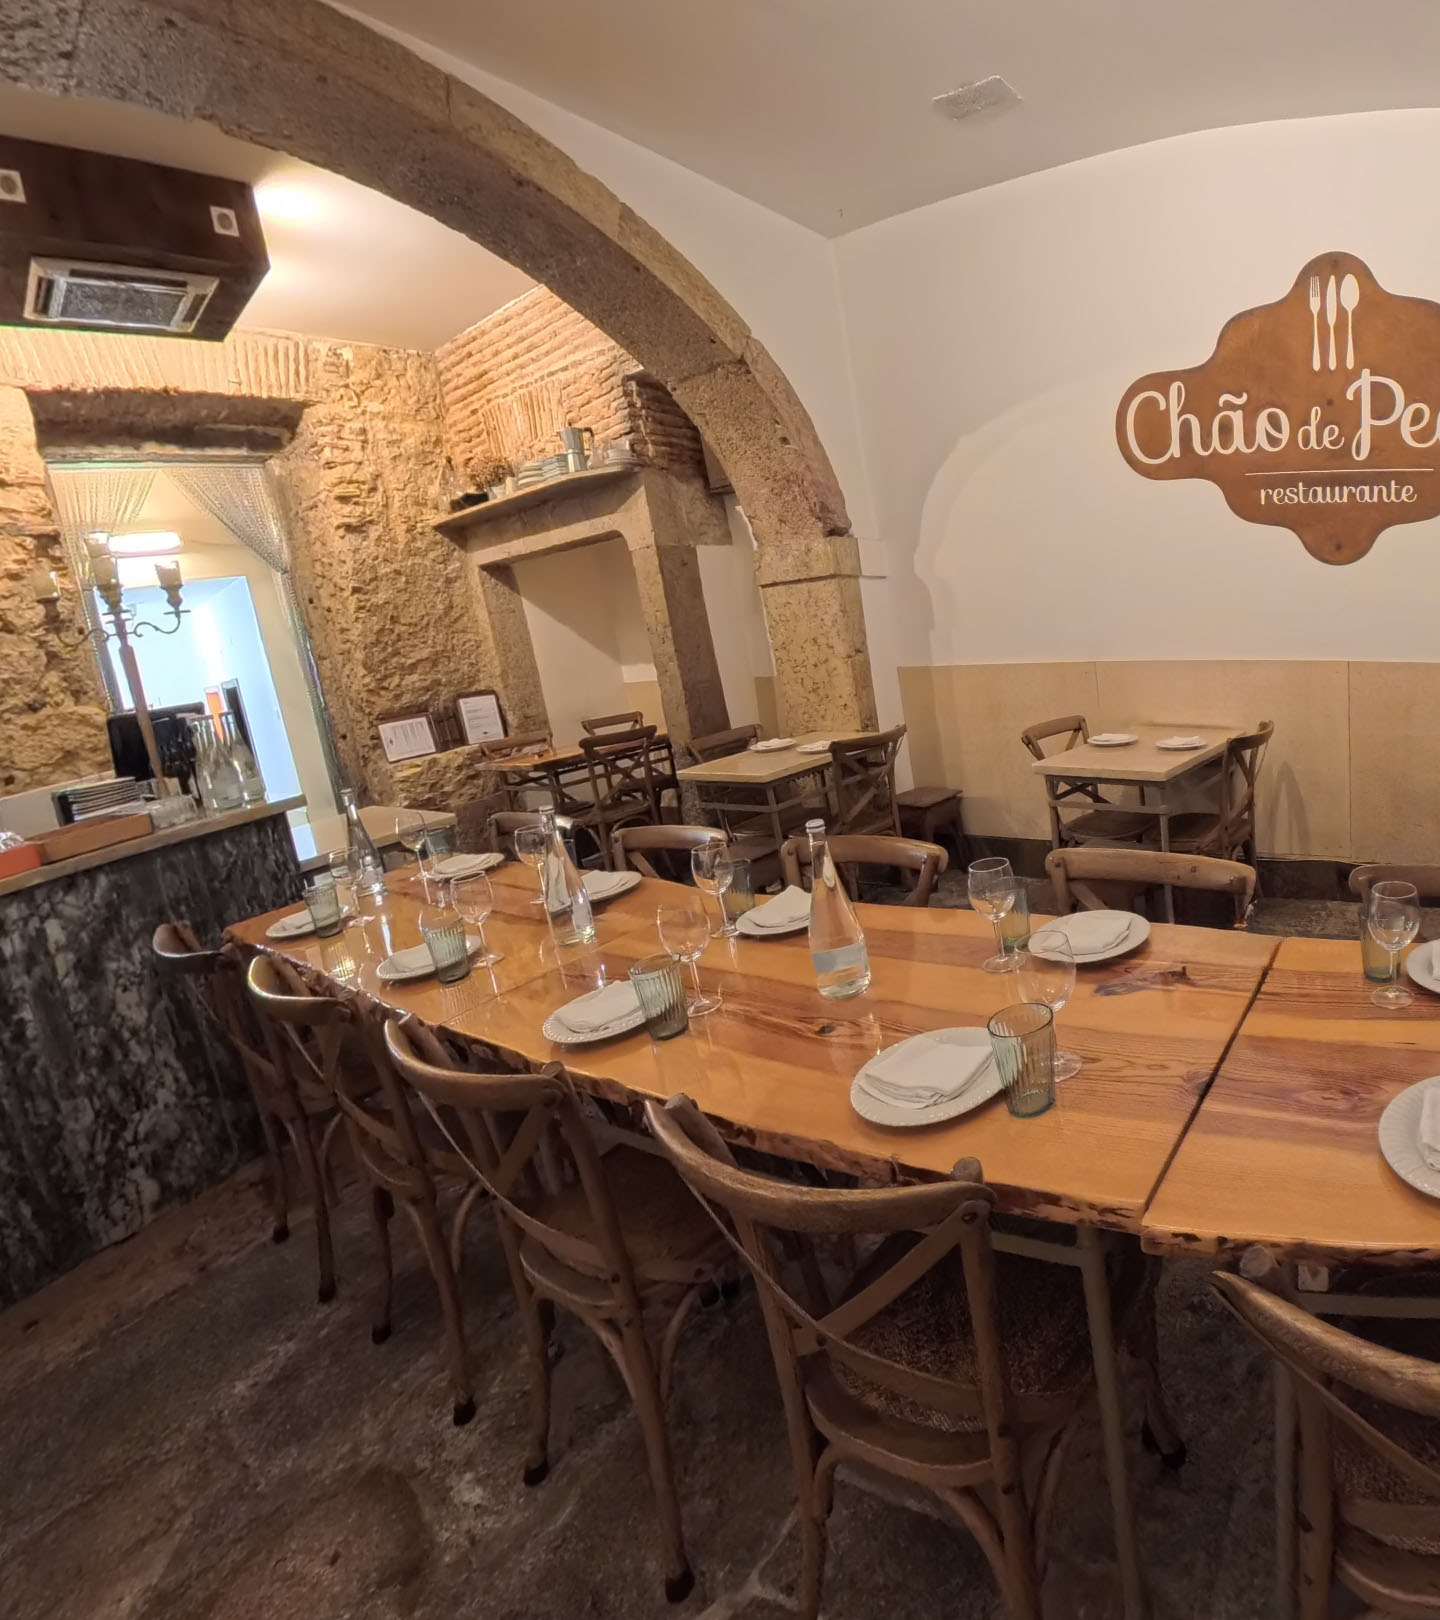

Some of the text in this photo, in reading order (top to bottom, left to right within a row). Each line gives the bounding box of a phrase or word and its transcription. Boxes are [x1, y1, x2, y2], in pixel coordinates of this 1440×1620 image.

[1126, 380, 1290, 465] Chão
[1297, 406, 1345, 450] de
[1260, 479, 1418, 505] restaurante
